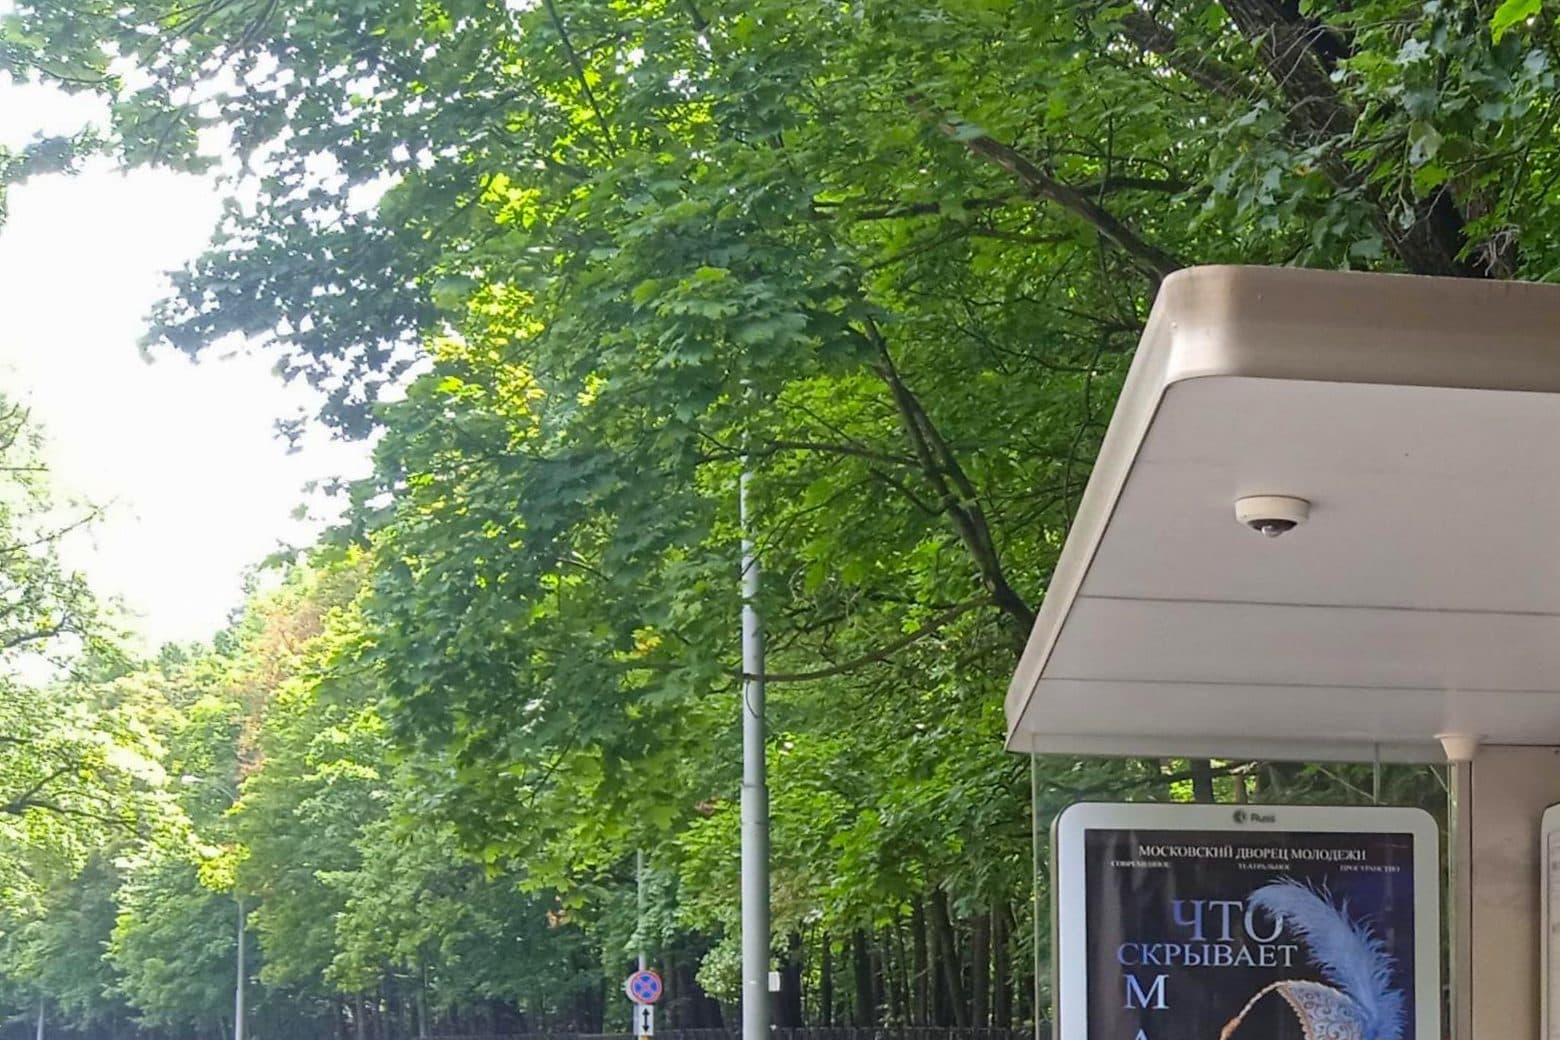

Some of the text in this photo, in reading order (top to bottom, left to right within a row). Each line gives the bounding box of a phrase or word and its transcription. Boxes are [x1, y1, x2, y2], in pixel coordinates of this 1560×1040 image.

[1139, 845, 1366, 861] МОСКОВСКИЙ ДВОРЕЦ МОЛОДЕЖИ
[1172, 900, 1284, 943] ЧТО
[1117, 943, 1298, 967] СКРЫВАЕТ
